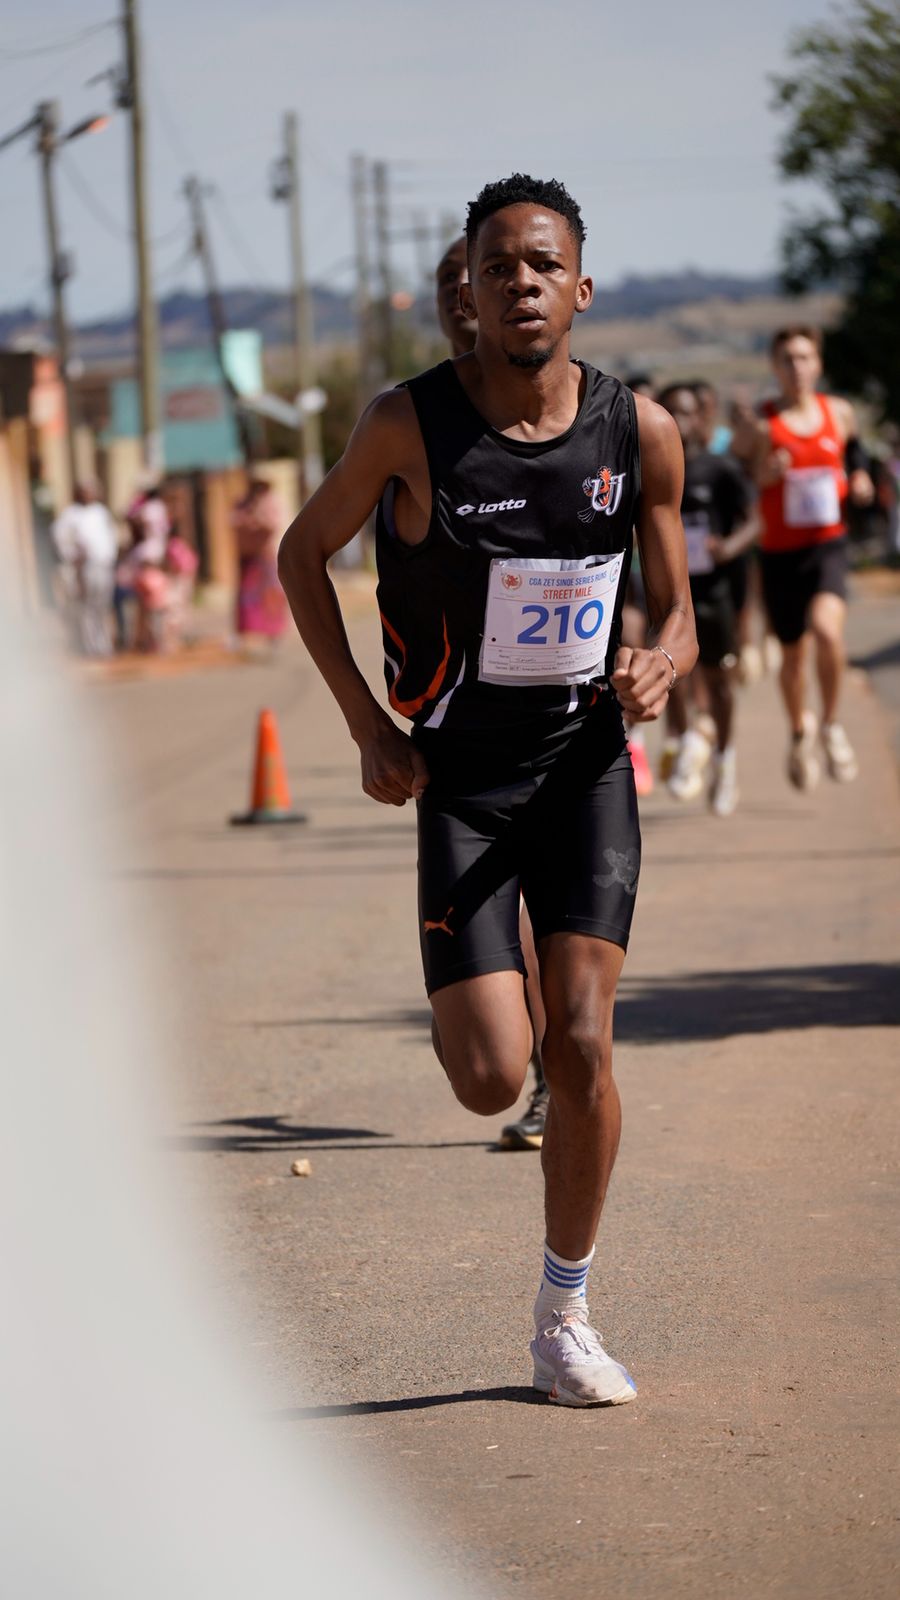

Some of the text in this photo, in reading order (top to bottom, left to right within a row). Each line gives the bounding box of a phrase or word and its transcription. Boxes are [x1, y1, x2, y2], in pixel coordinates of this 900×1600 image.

[478, 499, 527, 514] lotto
[529, 578, 541, 586] CGA
[543, 578, 556, 587] ZET
[575, 575, 594, 585] SERIES
[543, 586, 592, 599] STREET MILE
[517, 599, 604, 645] 210
